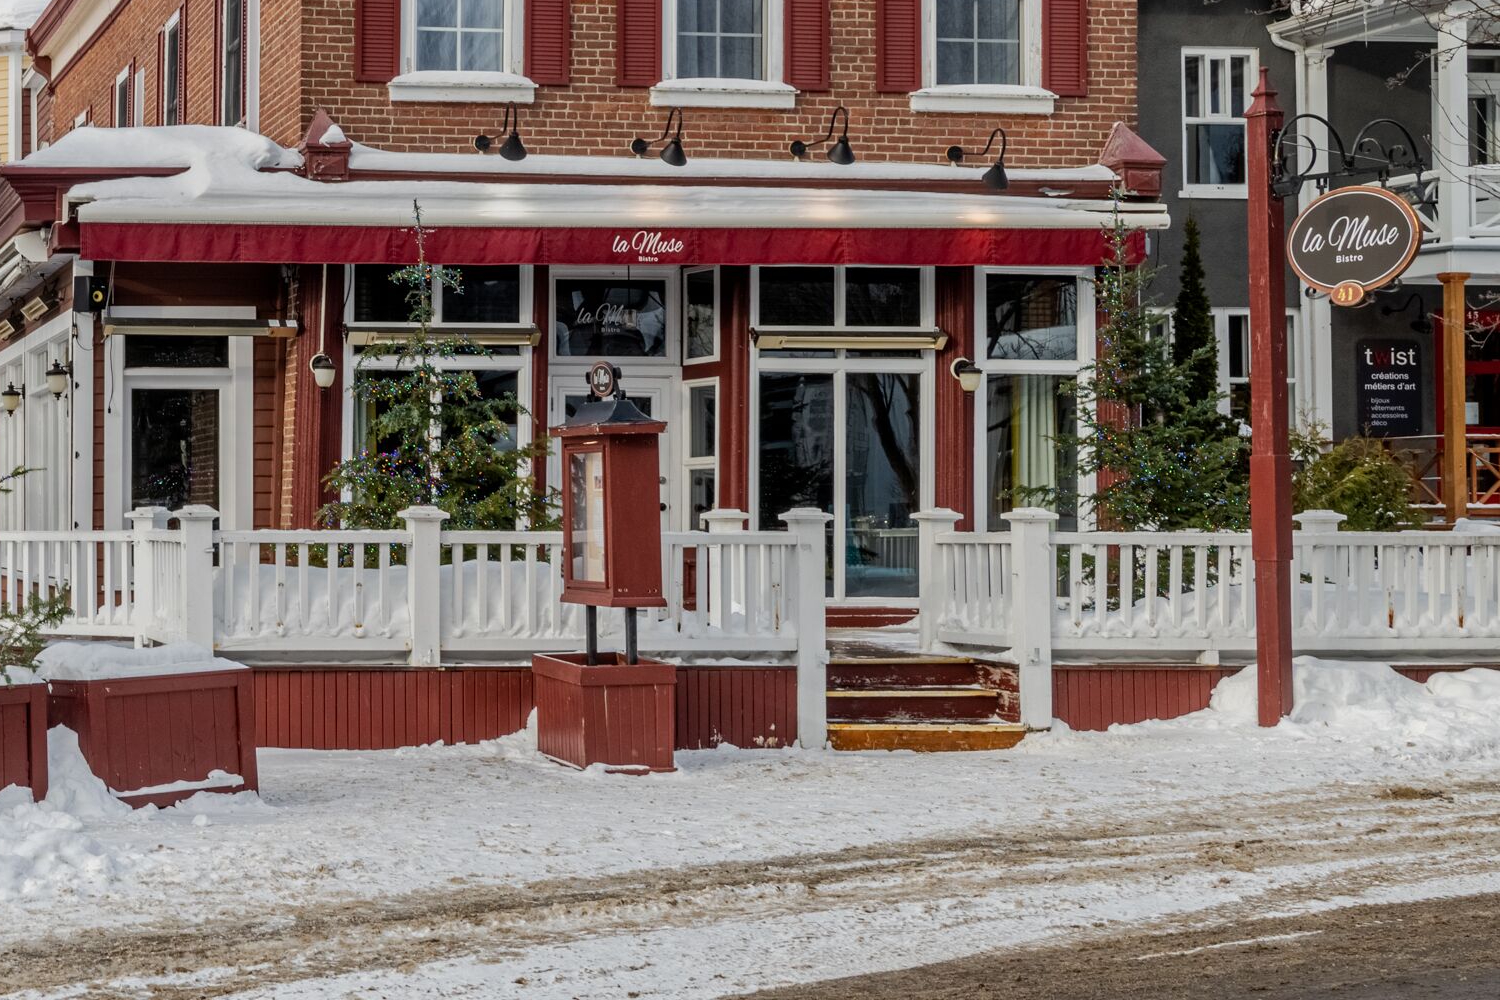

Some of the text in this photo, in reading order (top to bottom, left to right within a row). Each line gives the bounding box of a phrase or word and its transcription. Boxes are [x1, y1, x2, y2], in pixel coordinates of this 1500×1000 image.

[1302, 215, 1399, 253] la Muse
[612, 230, 684, 255] la Muse
[1336, 254, 1363, 263] Bistro
[1364, 347, 1416, 366] twist
[1371, 371, 1409, 380] créations
[1364, 382, 1416, 391] métiers d'art
